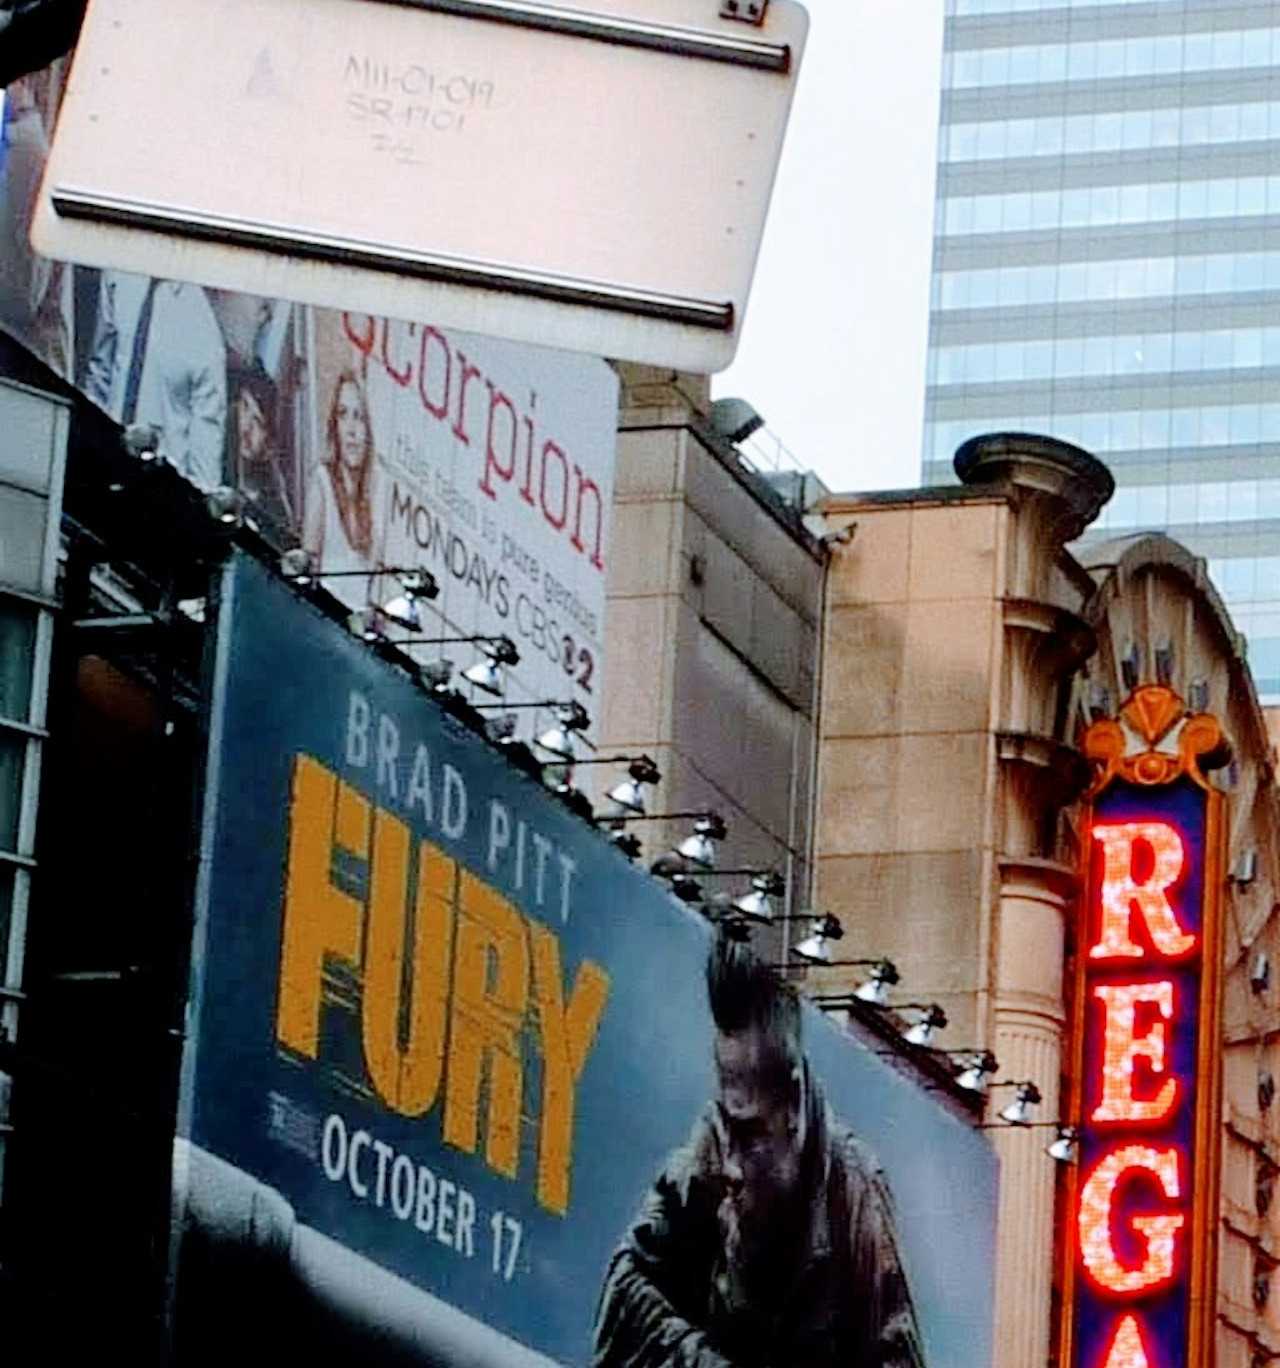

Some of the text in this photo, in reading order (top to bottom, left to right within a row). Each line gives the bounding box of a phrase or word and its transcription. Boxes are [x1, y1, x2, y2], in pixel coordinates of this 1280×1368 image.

[390, 483, 510, 619] MONDAYS
[515, 592, 561, 663] CBS
[346, 693, 577, 925] BRAD PITT
[276, 751, 611, 1218] FURY
[322, 1113, 523, 1281] OCTOBER 17
